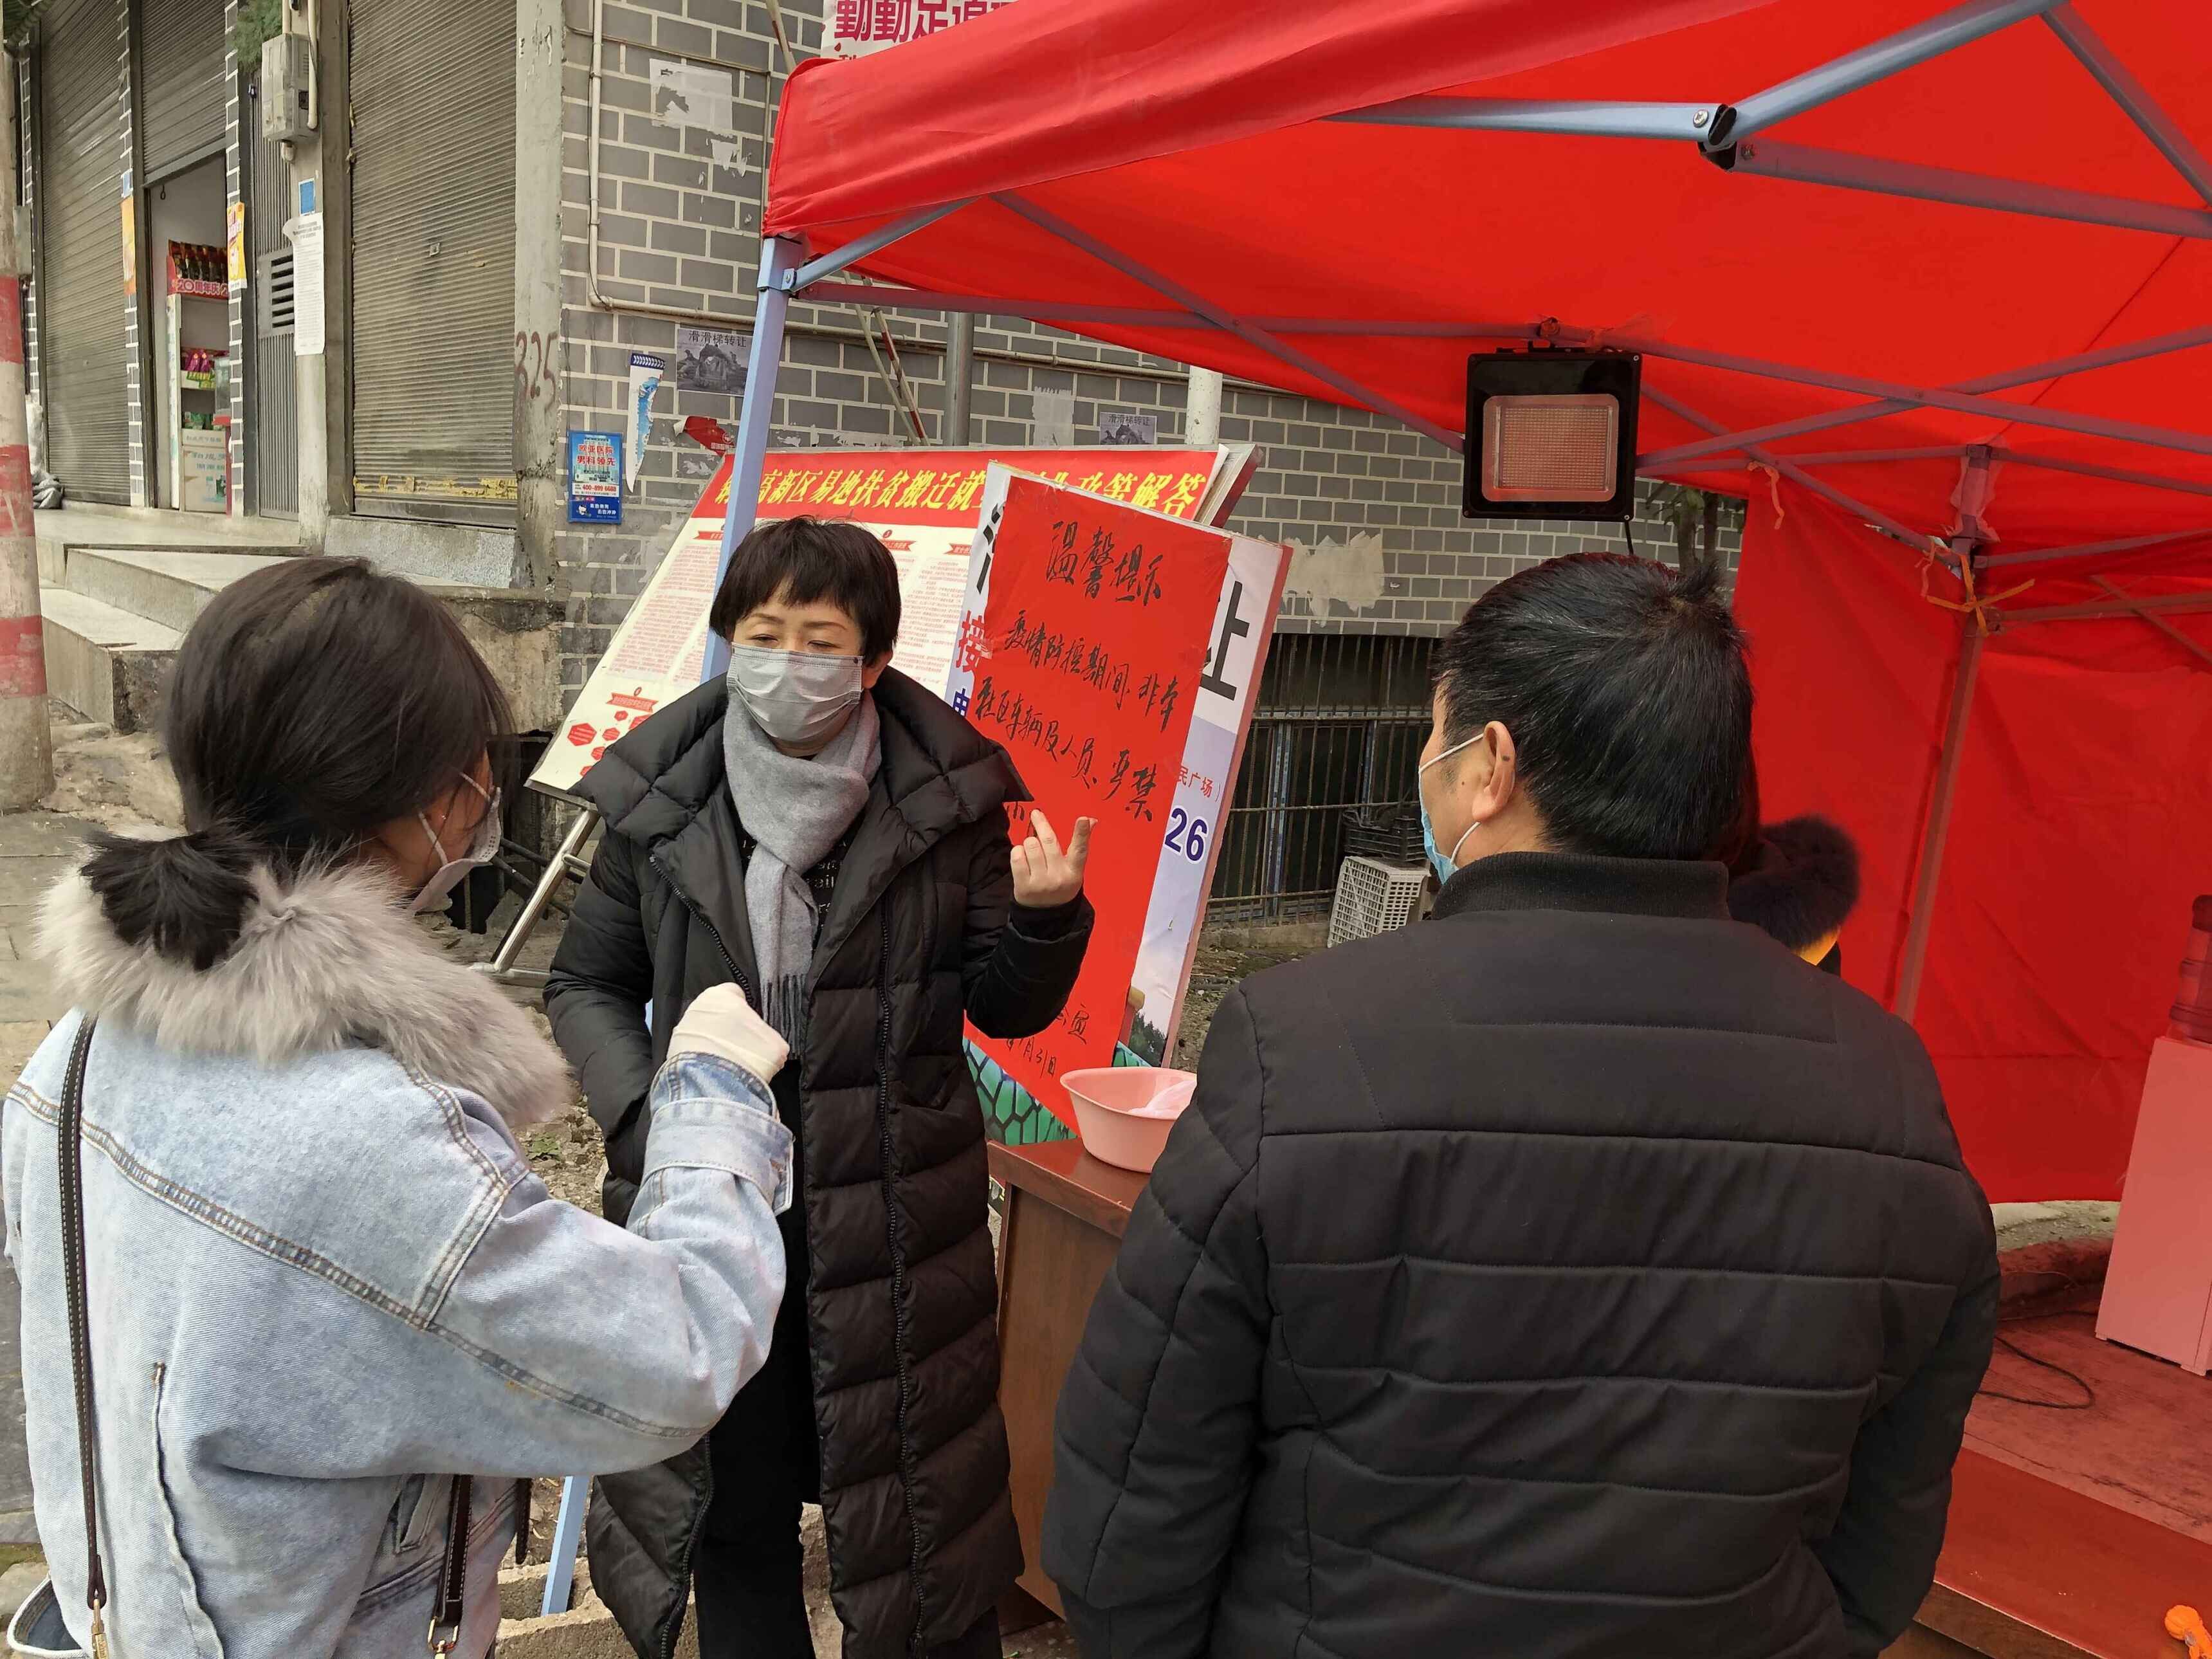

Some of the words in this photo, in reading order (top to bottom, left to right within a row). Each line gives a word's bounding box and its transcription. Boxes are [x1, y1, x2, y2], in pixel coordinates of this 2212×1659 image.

[689, 330, 747, 348] 滑滑梯转让
[1047, 521, 1164, 607] 温馨提示
[1164, 807, 1208, 862] 26
